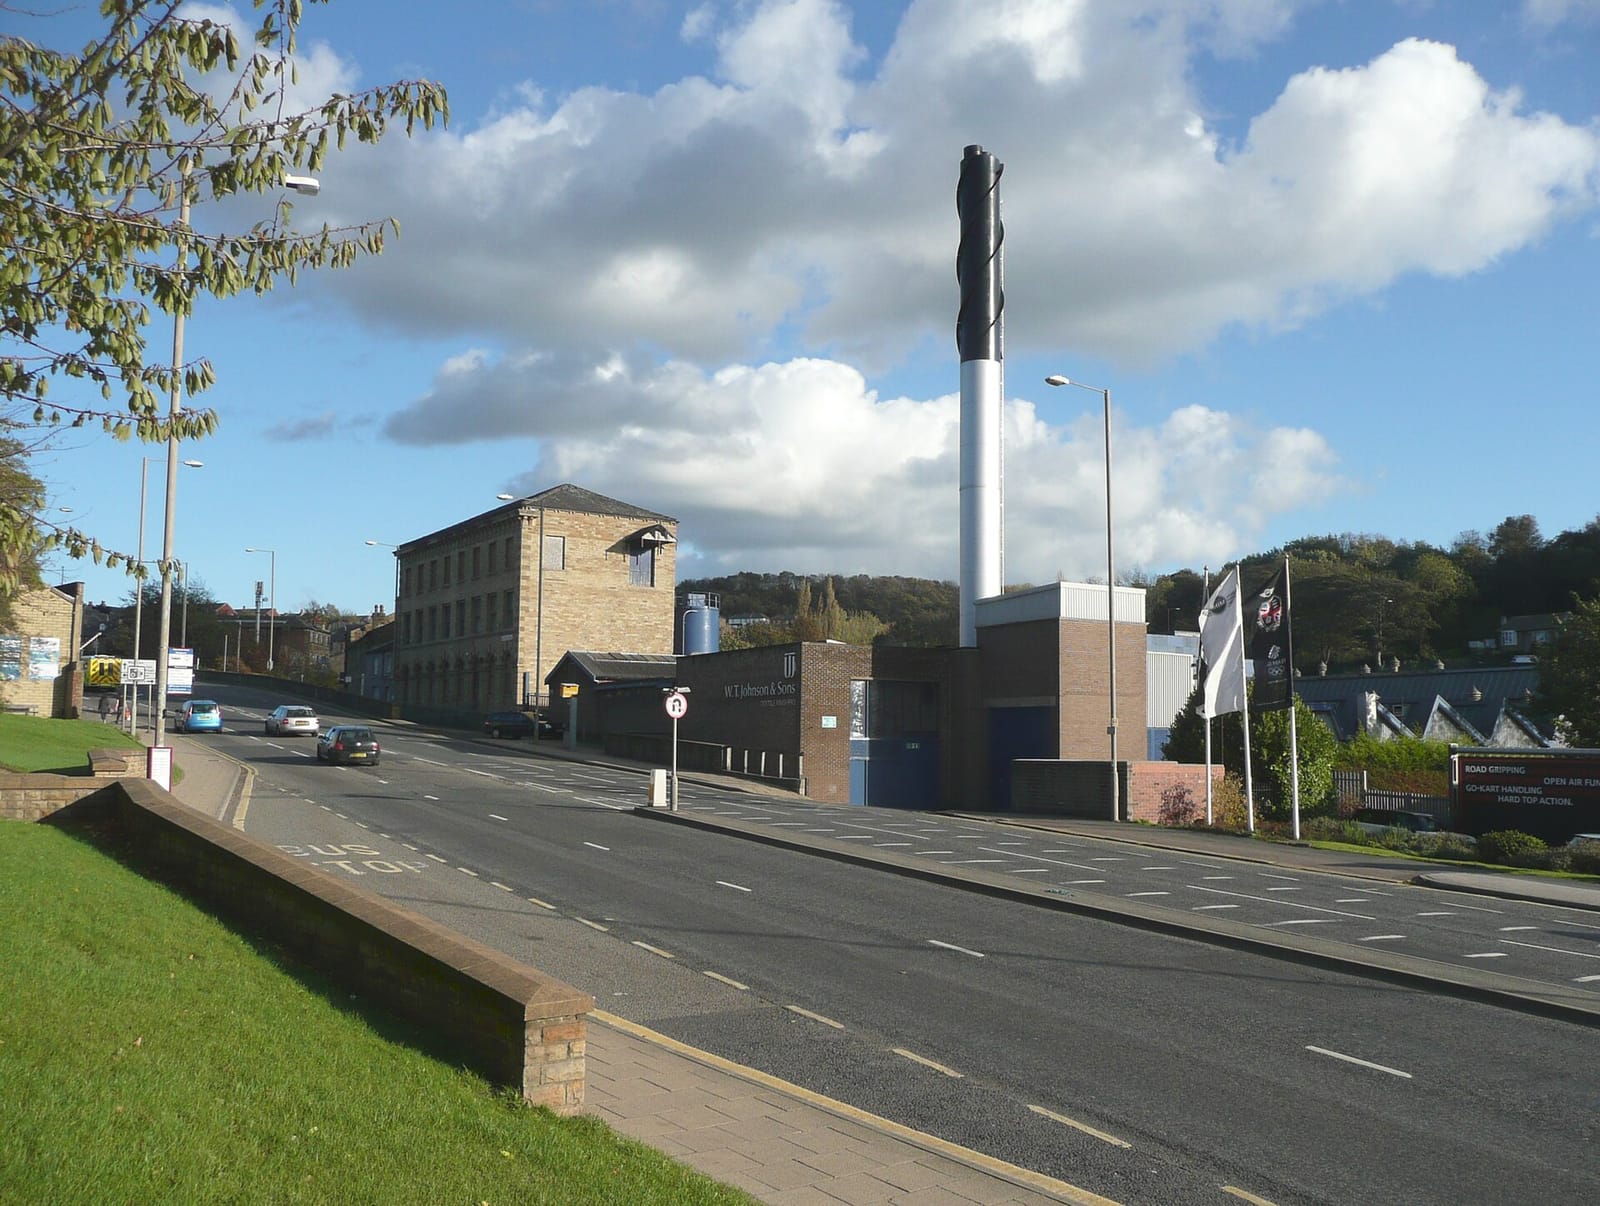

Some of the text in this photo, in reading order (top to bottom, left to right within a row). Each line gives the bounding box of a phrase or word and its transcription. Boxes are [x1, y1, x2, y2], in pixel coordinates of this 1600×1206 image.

[769, 682, 776, 695] &
[777, 681, 796, 695] Sons
[1465, 765, 1526, 774] ROAD GRIPPING
[1543, 777, 1566, 785] OPEN
[1568, 778, 1583, 786] AIR
[1465, 784, 1543, 795] GO-KART HANDLING
[1497, 795, 1574, 806] HARD TOP ACTION.
